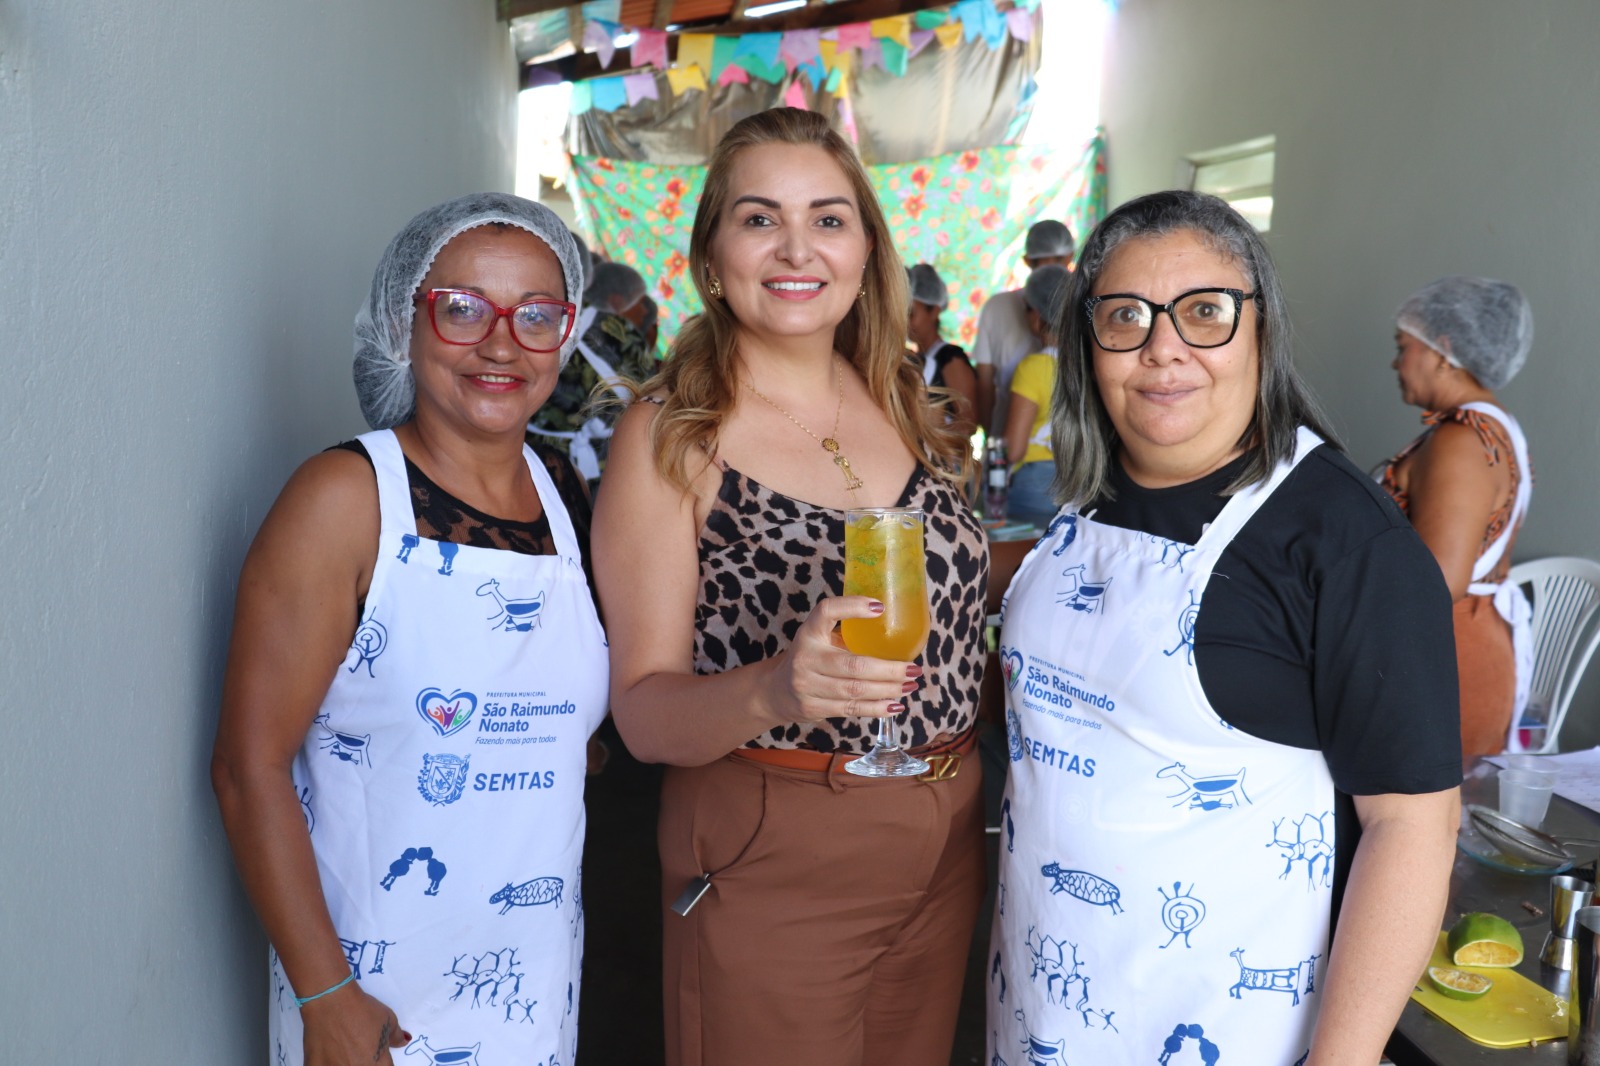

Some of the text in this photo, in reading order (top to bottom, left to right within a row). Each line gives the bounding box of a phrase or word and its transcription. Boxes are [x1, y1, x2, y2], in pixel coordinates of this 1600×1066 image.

[1029, 655, 1086, 682] PREFEITURA MUNICIPAL
[1023, 680, 1073, 709] Nonato
[1027, 665, 1115, 711] São Raimundo
[482, 700, 576, 717] São Raimundo
[1022, 698, 1103, 730] Fazendo mais para todos
[478, 718, 530, 733] Nonato
[475, 734, 557, 746] Fazendo mais para todos
[1024, 737, 1096, 777] SEMTAS
[473, 770, 556, 792] SEMTAS
